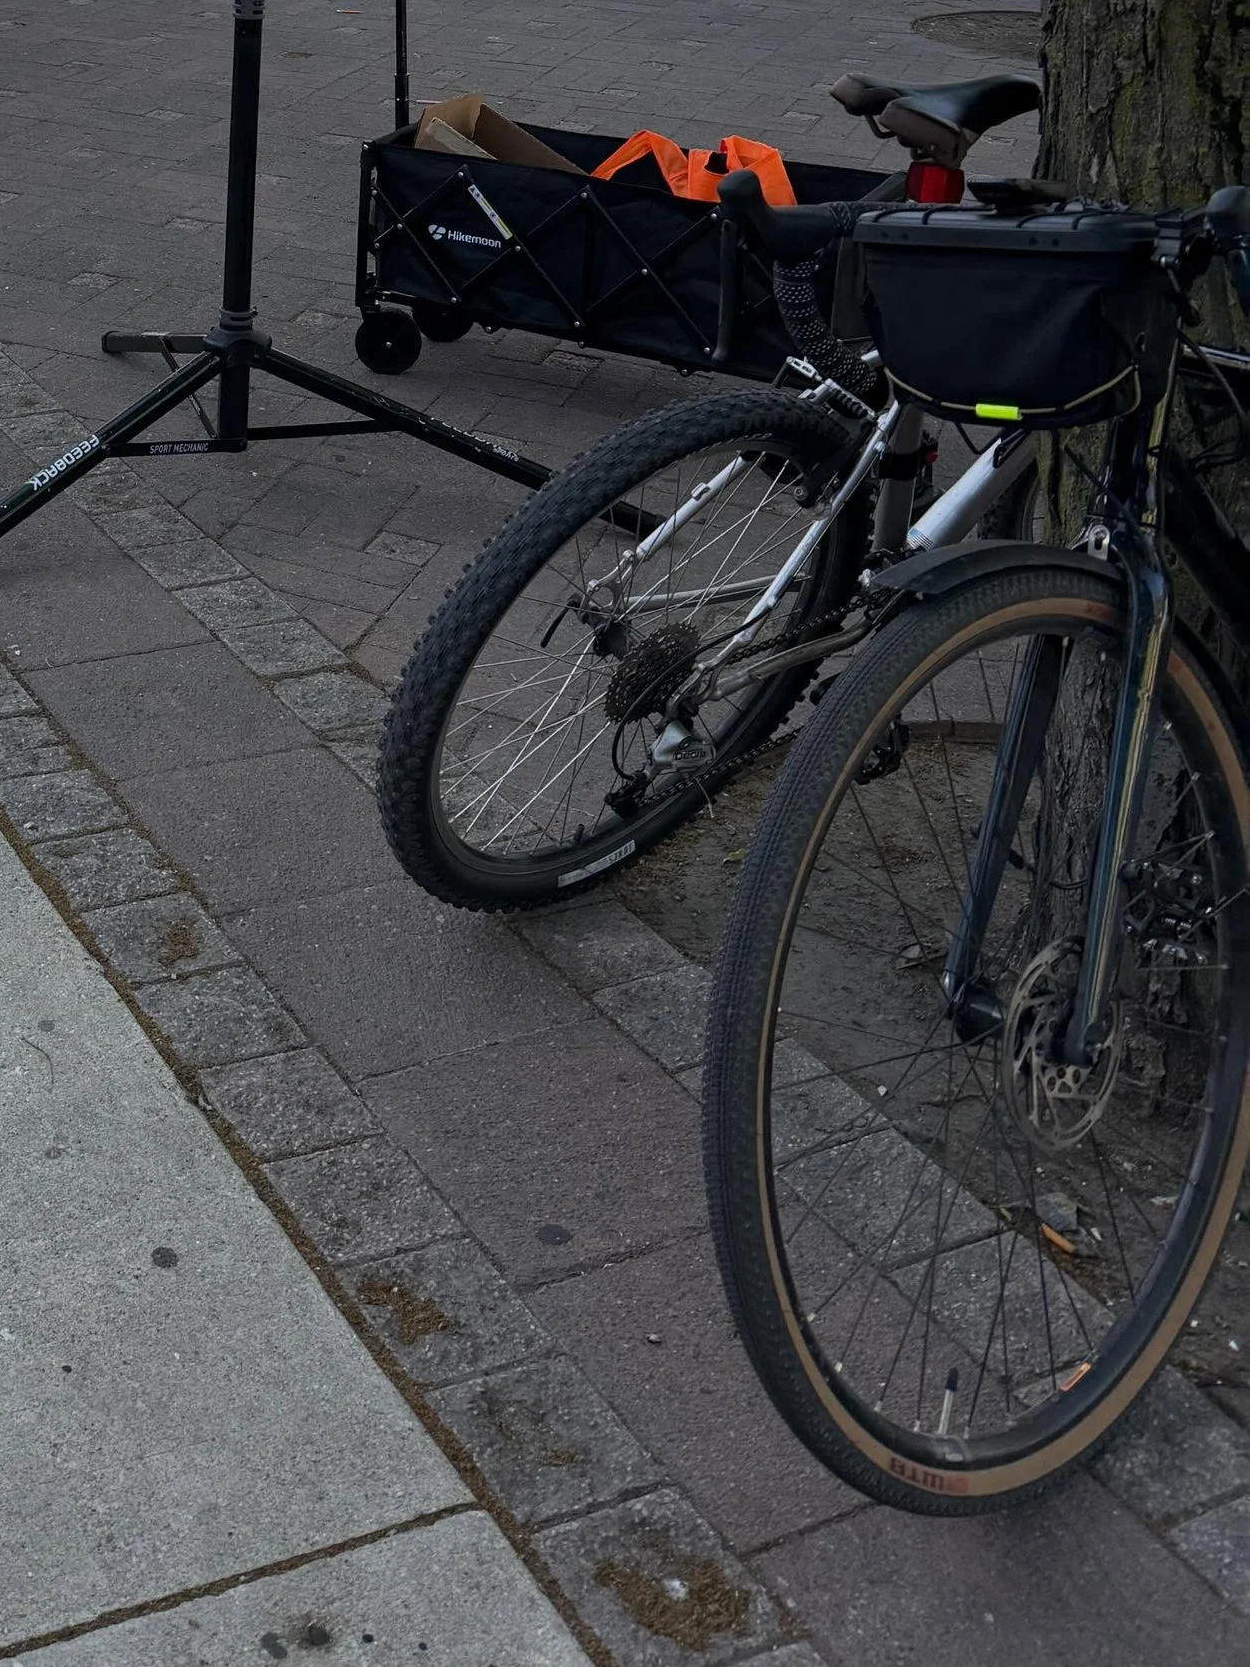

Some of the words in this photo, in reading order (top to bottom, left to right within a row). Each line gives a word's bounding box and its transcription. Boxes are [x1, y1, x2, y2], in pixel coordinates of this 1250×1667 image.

[447, 229, 502, 249] Hikemoon
[149, 444, 172, 454] SPORT
[173, 442, 209, 453] MECHANIC
[24, 434, 100, 491] FEEDBACK
